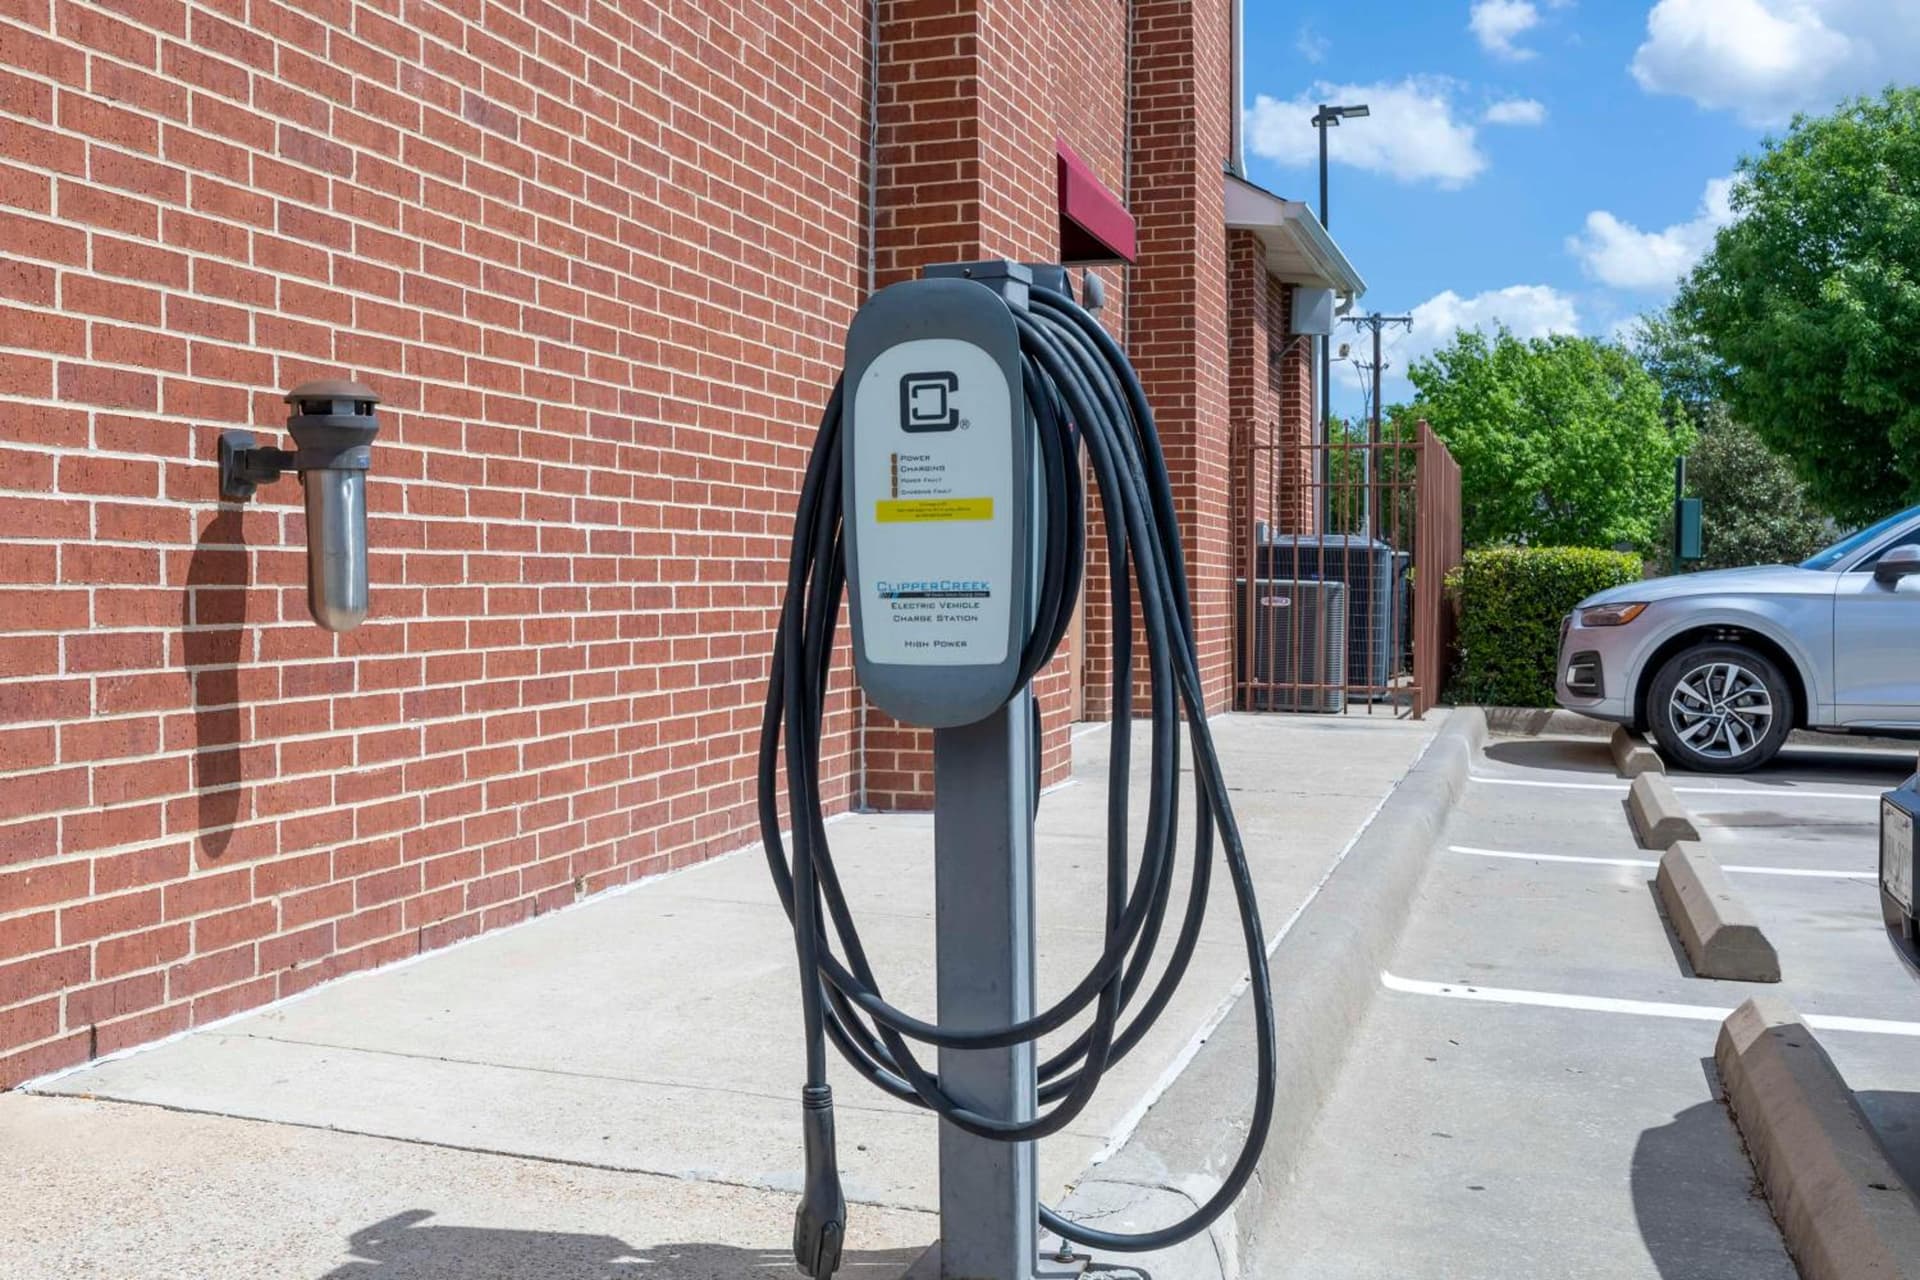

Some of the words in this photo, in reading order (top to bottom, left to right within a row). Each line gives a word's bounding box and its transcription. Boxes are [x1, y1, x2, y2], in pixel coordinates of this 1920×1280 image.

[891, 602, 936, 610] ELECTRIC
[939, 601, 980, 609] VEHICLE
[936, 614, 978, 622] STATION
[904, 640, 929, 648] HIGH
[933, 640, 968, 648] POWER
